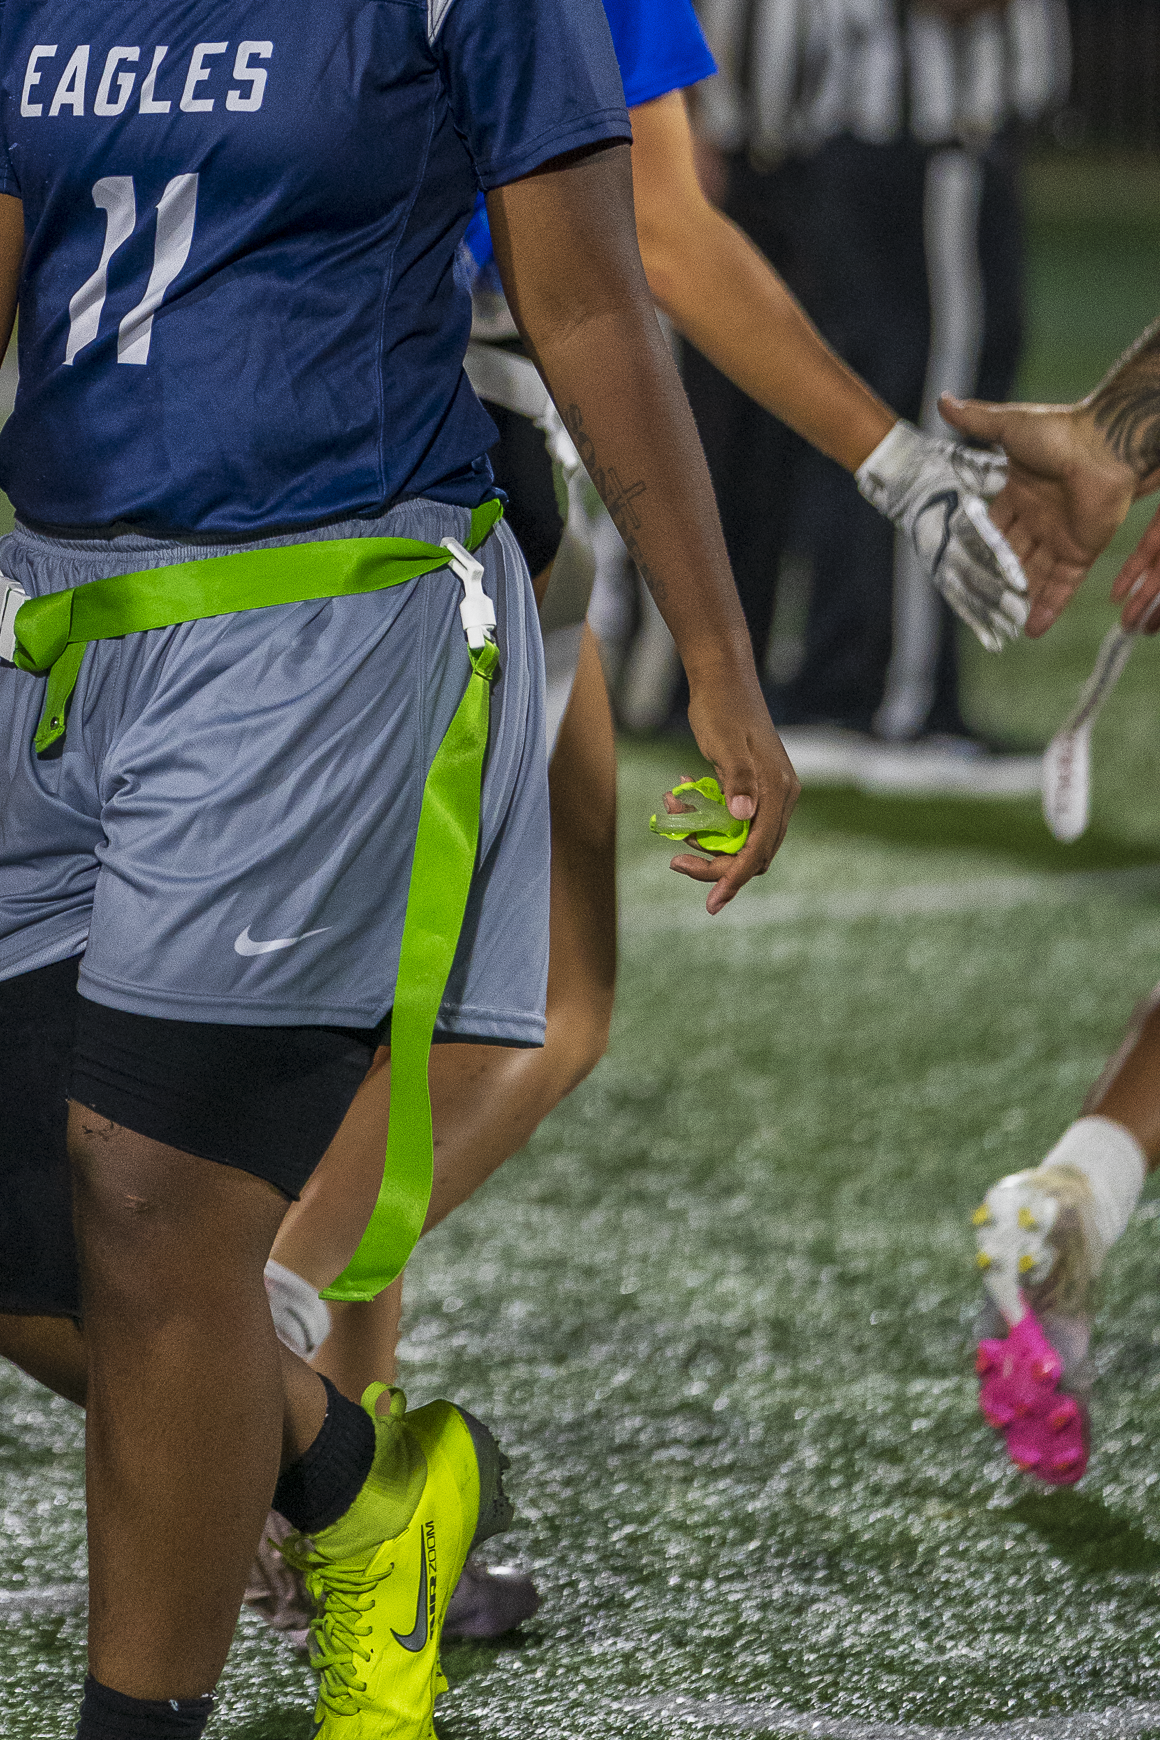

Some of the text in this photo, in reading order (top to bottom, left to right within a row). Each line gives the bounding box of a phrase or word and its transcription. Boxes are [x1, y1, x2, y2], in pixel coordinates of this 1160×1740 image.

[19, 40, 274, 118] EAGLES
[62, 172, 200, 366] 11
[425, 1520, 436, 1574] ZOOM
